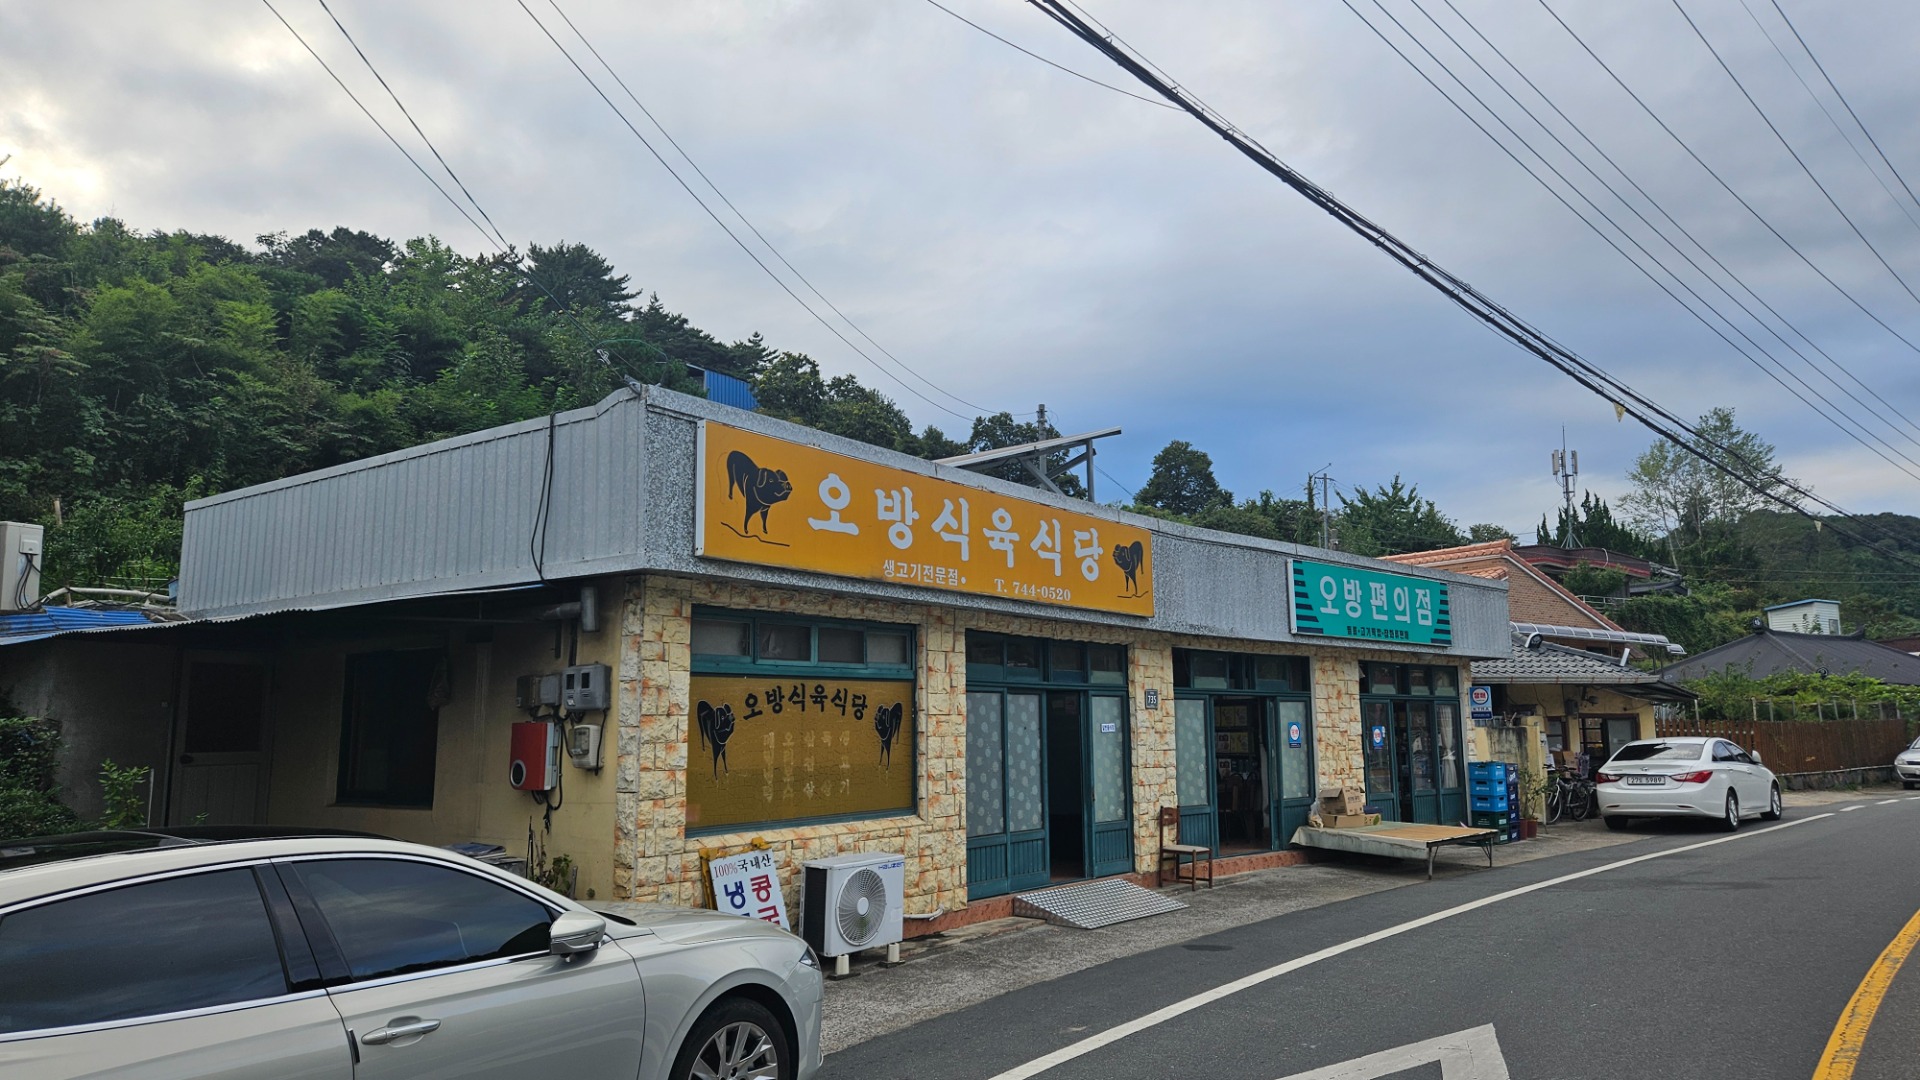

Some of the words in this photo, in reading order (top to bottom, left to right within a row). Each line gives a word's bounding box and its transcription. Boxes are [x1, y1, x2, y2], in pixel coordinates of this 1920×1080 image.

[807, 472, 1104, 582] 오방식육식당
[994, 578, 1007, 594] T.
[1012, 582, 1072, 601] 744-0520
[1319, 575, 1433, 626] 오방편의점
[742, 683, 868, 721] 오방식육식당
[1147, 695, 1157, 704] 735
[839, 730, 852, 796] 생고기
